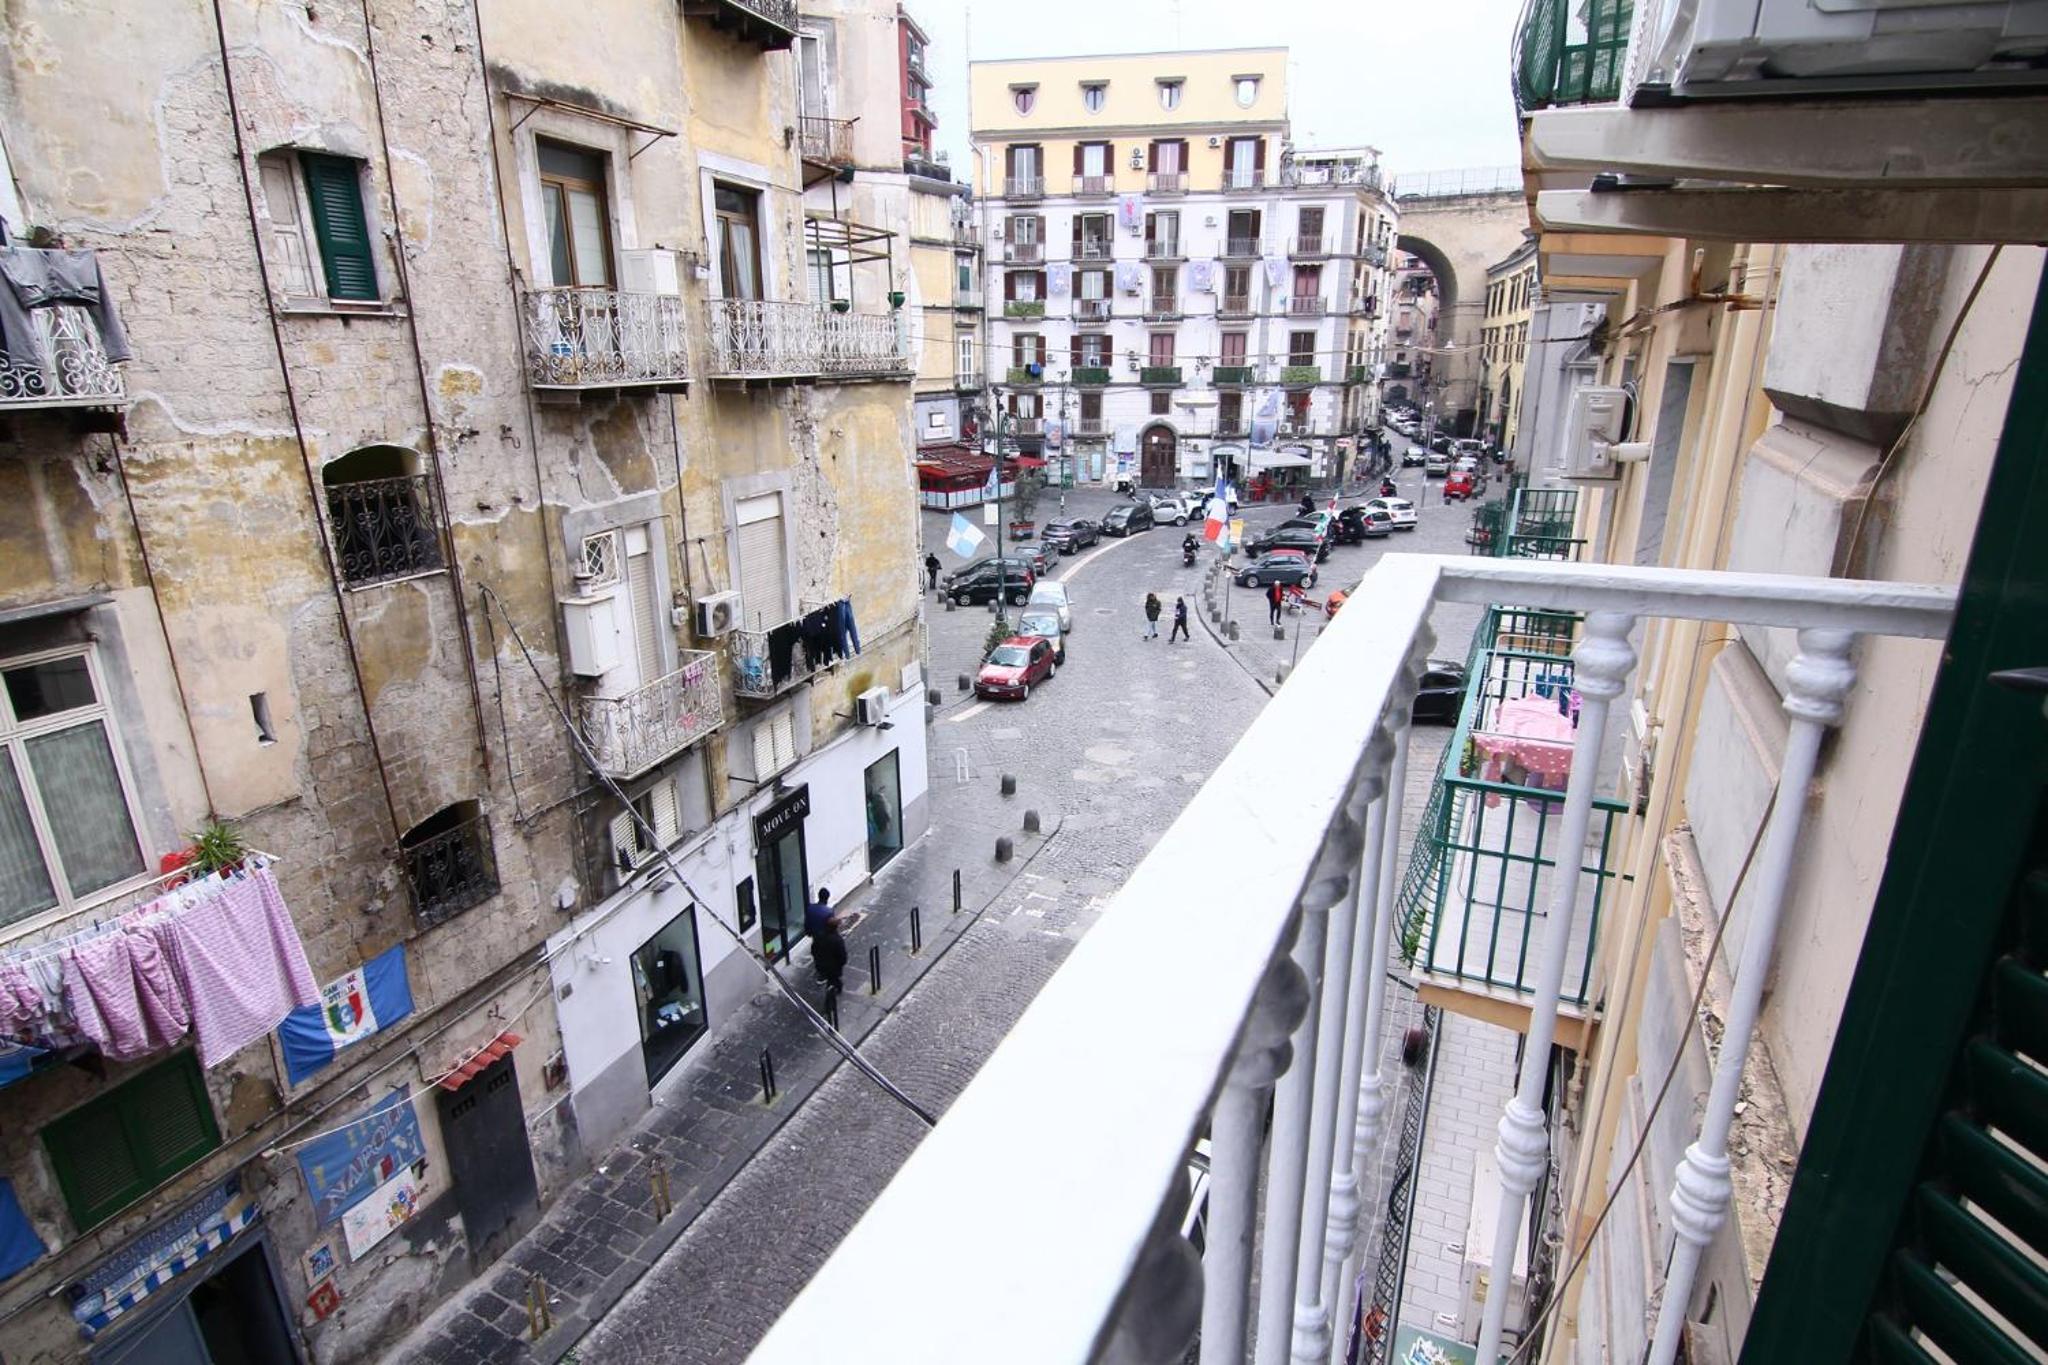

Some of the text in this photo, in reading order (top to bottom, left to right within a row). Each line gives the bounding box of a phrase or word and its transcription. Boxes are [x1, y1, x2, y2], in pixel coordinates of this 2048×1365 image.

[763, 797, 807, 836] MOVE ON
[323, 972, 356, 997] CAMNE
[87, 1237, 148, 1284] NAPOLI
[163, 1191, 222, 1231] EUROPA
